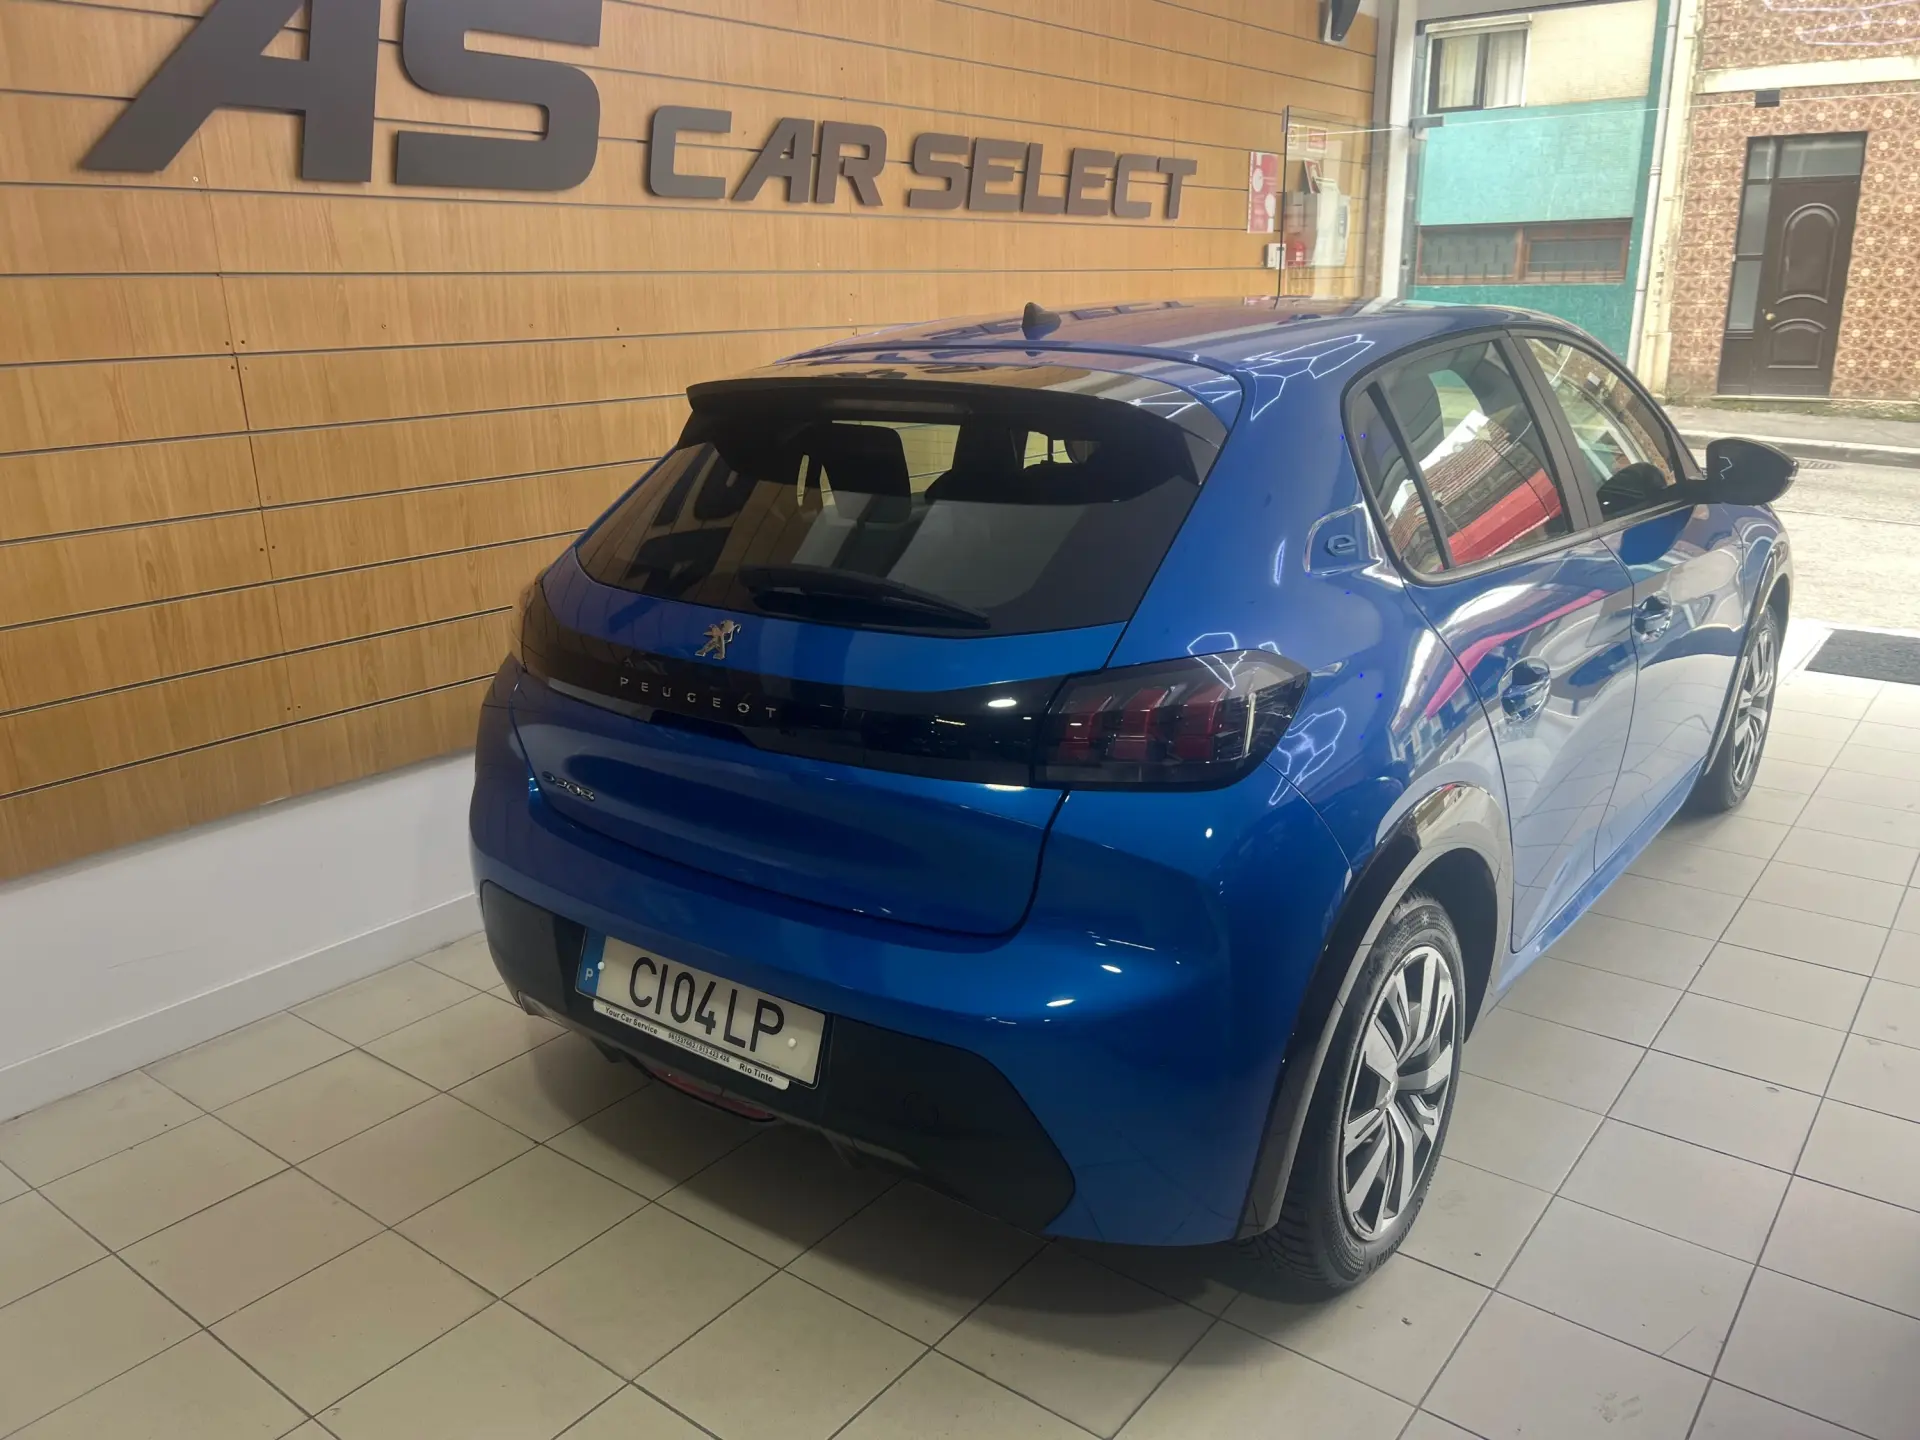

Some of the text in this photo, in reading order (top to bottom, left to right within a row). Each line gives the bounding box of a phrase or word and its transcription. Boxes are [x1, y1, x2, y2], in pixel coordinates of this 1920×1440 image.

[81, 0, 601, 191] AS
[650, 104, 887, 207] CAR
[908, 132, 1198, 220] SELECT
[620, 676, 777, 719] PEUGEOT
[584, 967, 594, 981] P
[605, 1006, 620, 1018] Your
[620, 1013, 632, 1024] Car
[633, 1018, 658, 1035] Service
[740, 1062, 752, 1074] Rio
[753, 1068, 774, 1083] Tinto
